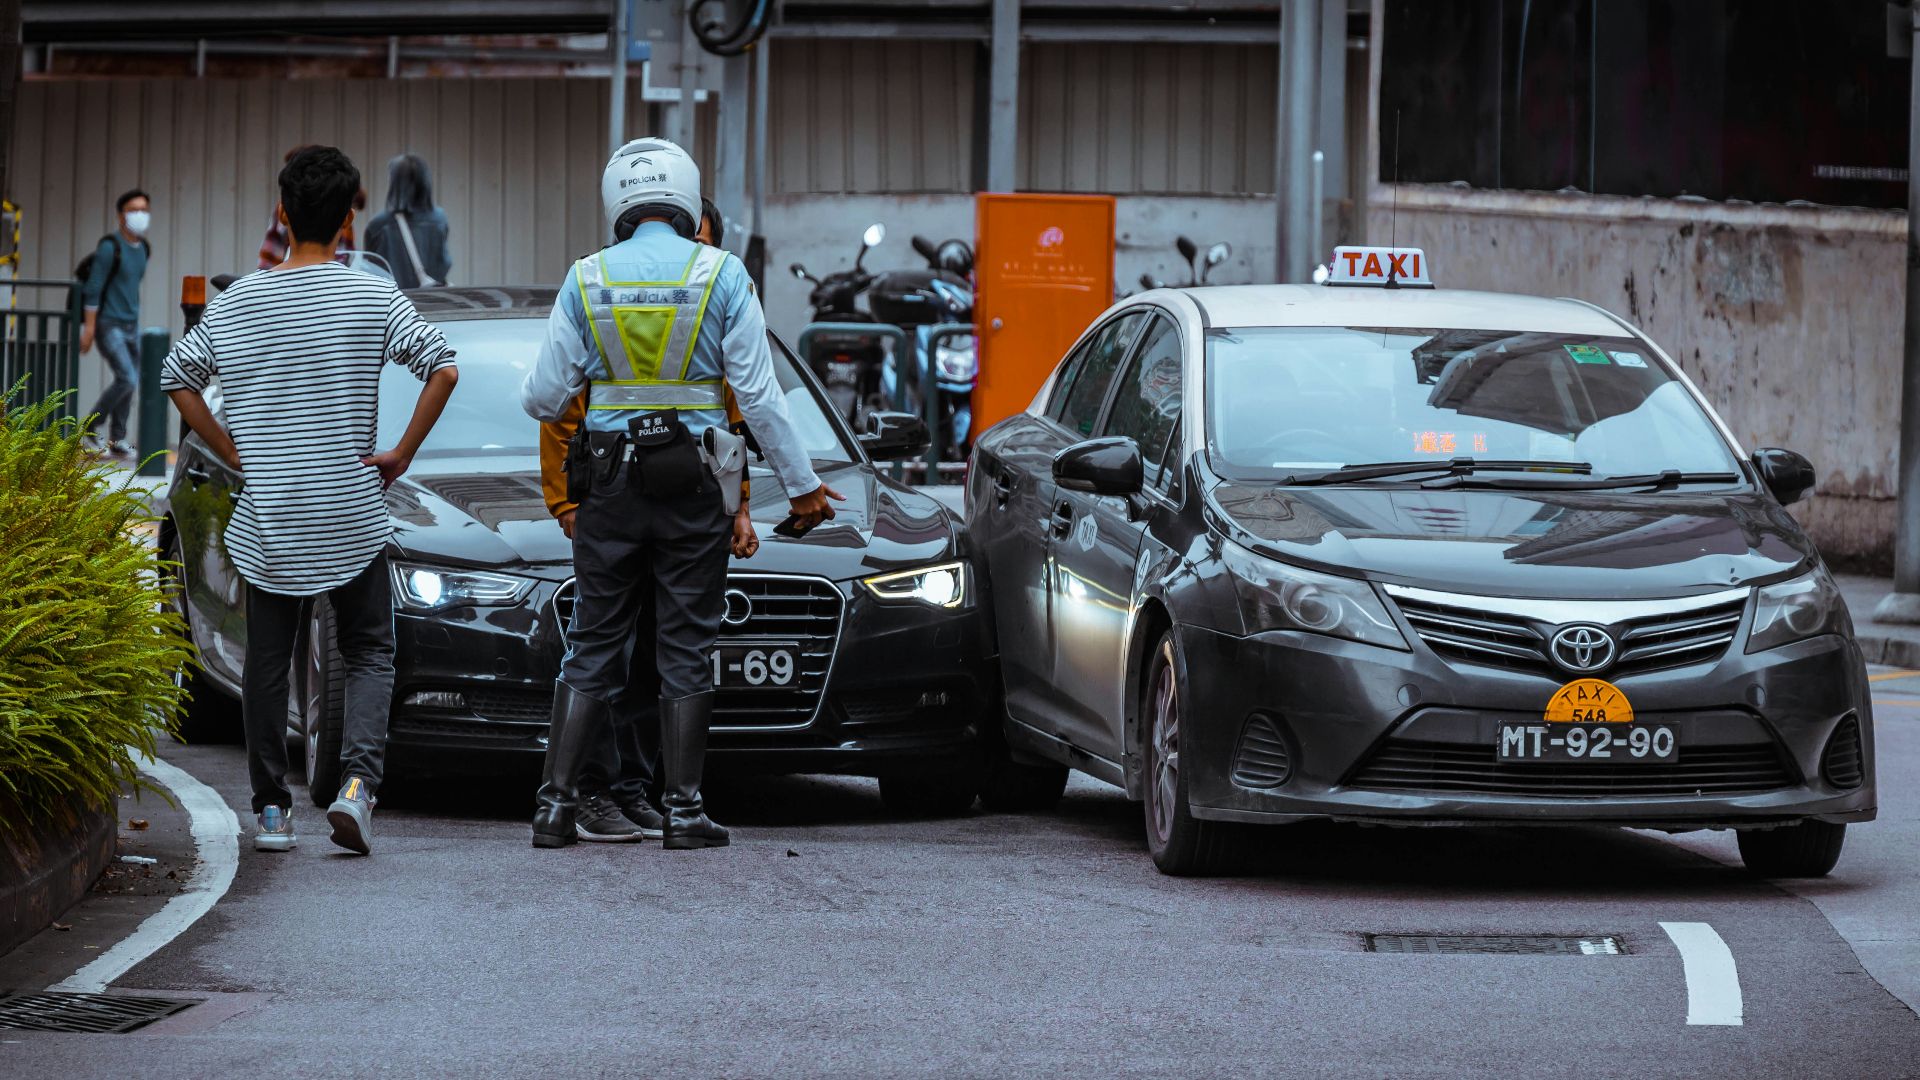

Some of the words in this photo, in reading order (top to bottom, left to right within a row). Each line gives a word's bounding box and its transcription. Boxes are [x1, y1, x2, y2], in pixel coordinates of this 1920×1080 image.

[1342, 252, 1420, 278] TAXI
[638, 425, 670, 436] POLÍCIA
[710, 649, 794, 686] 1-69
[1561, 684, 1616, 706] TAXI
[1572, 708, 1607, 722] 548
[1502, 726, 1674, 758] MT-92-90
